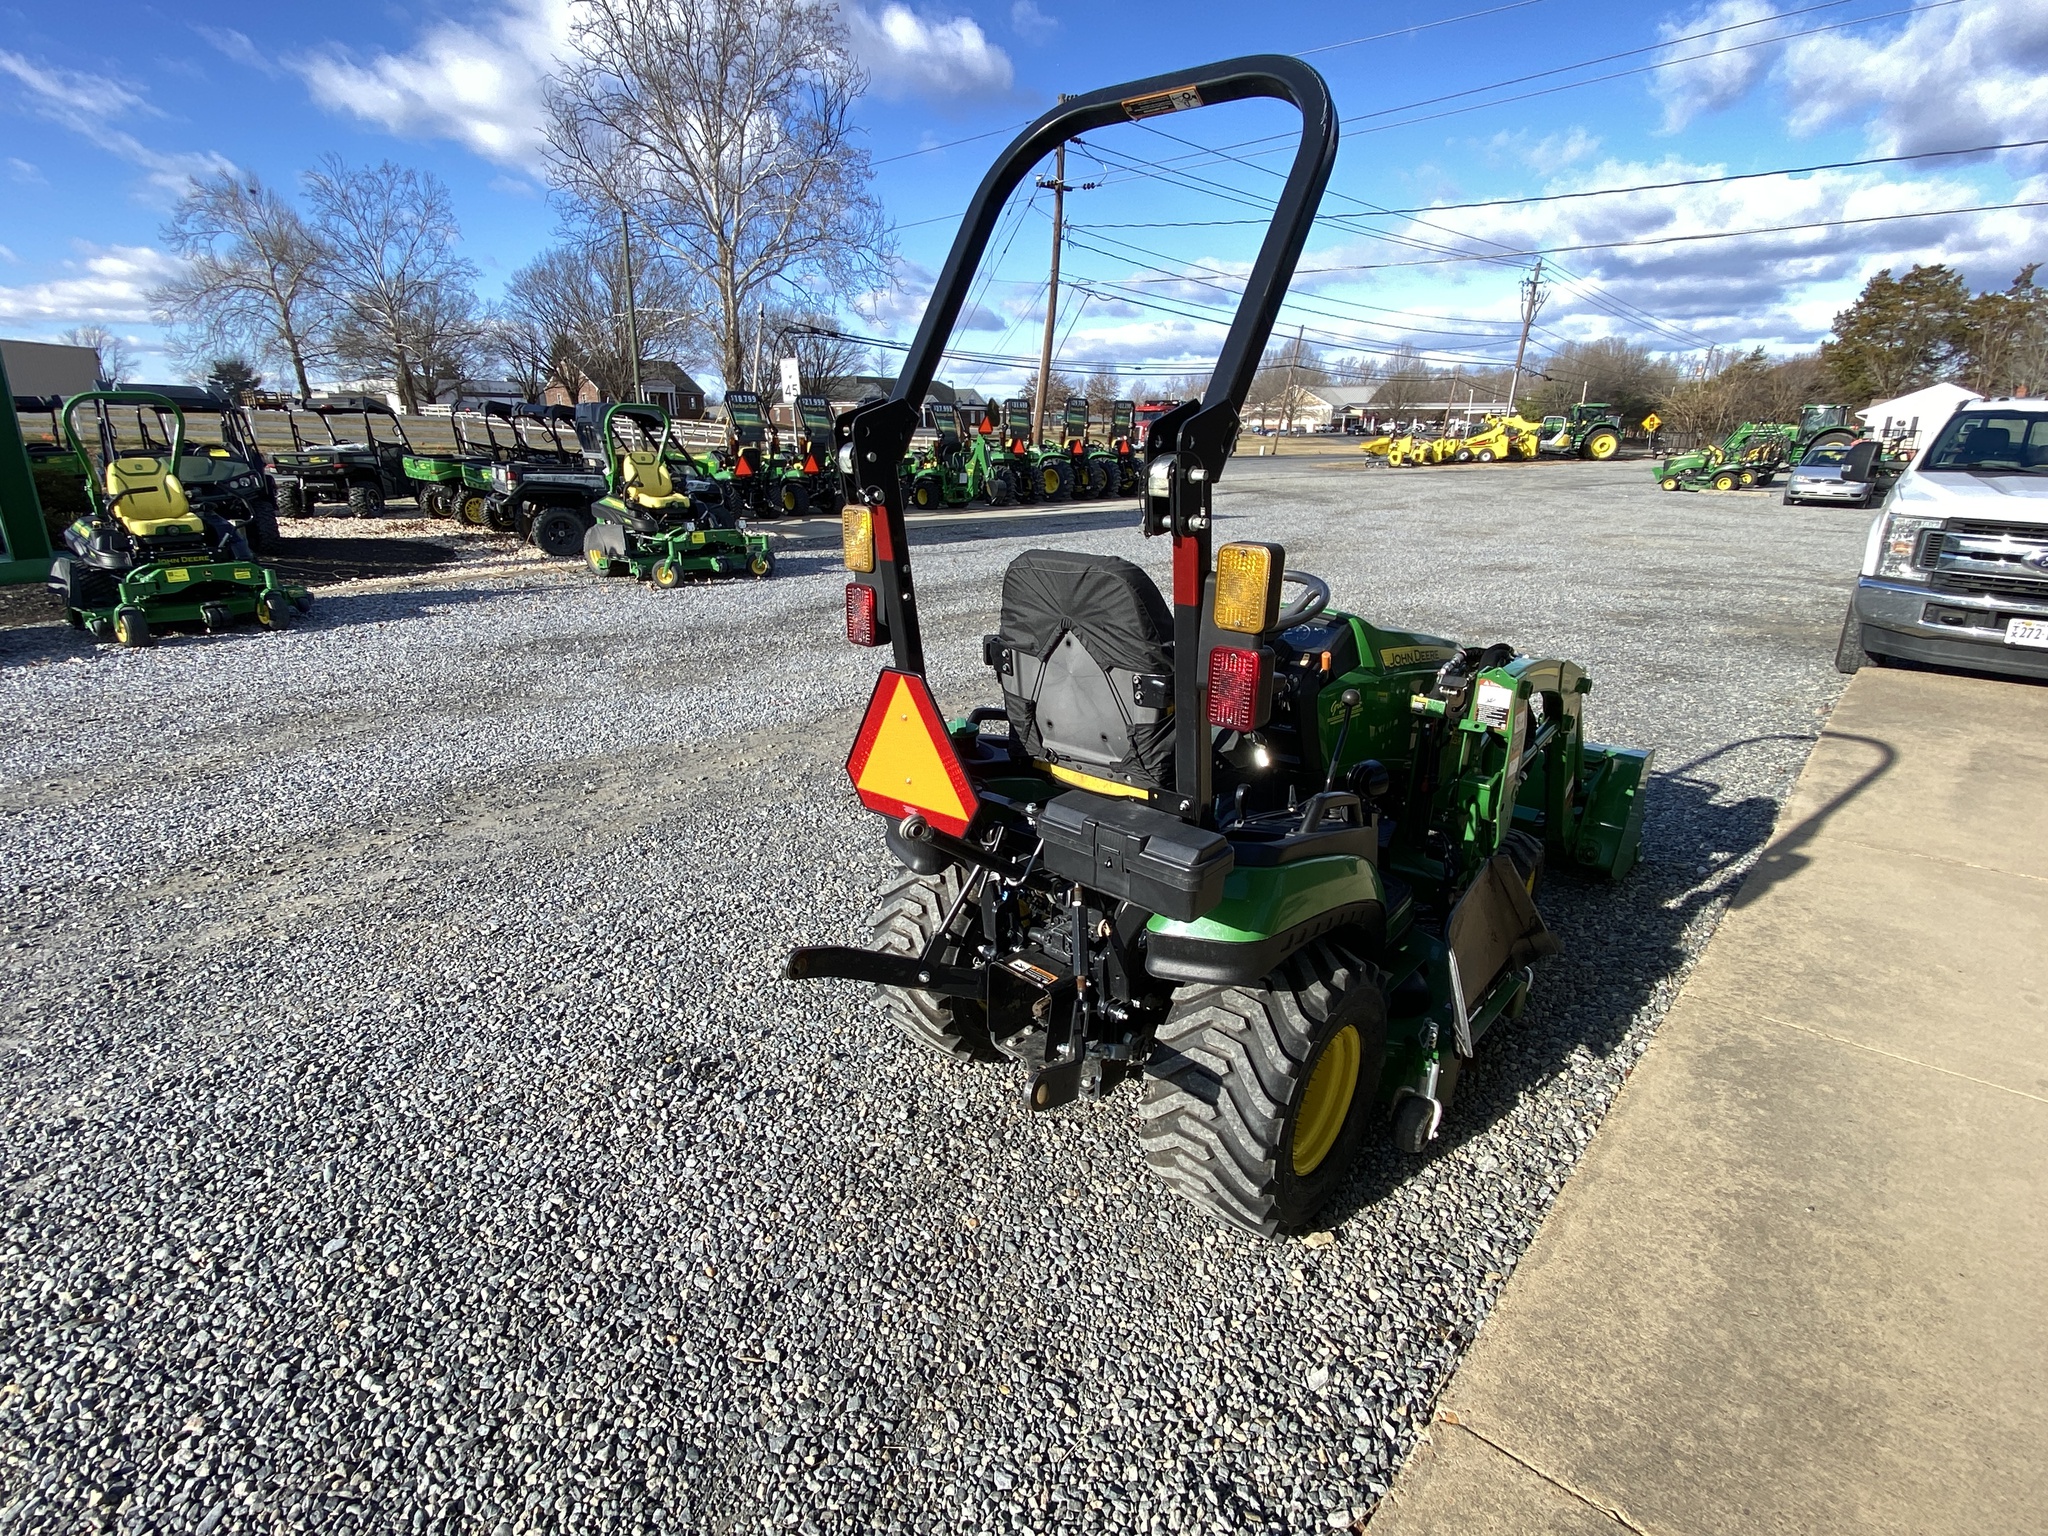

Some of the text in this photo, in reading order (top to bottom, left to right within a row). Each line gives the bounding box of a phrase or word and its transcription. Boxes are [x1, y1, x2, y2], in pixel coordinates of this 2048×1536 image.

[785, 383, 798, 397] 45
[158, 554, 210, 564] JOHN DEERE
[1389, 649, 1440, 666] JOHN DEERE
